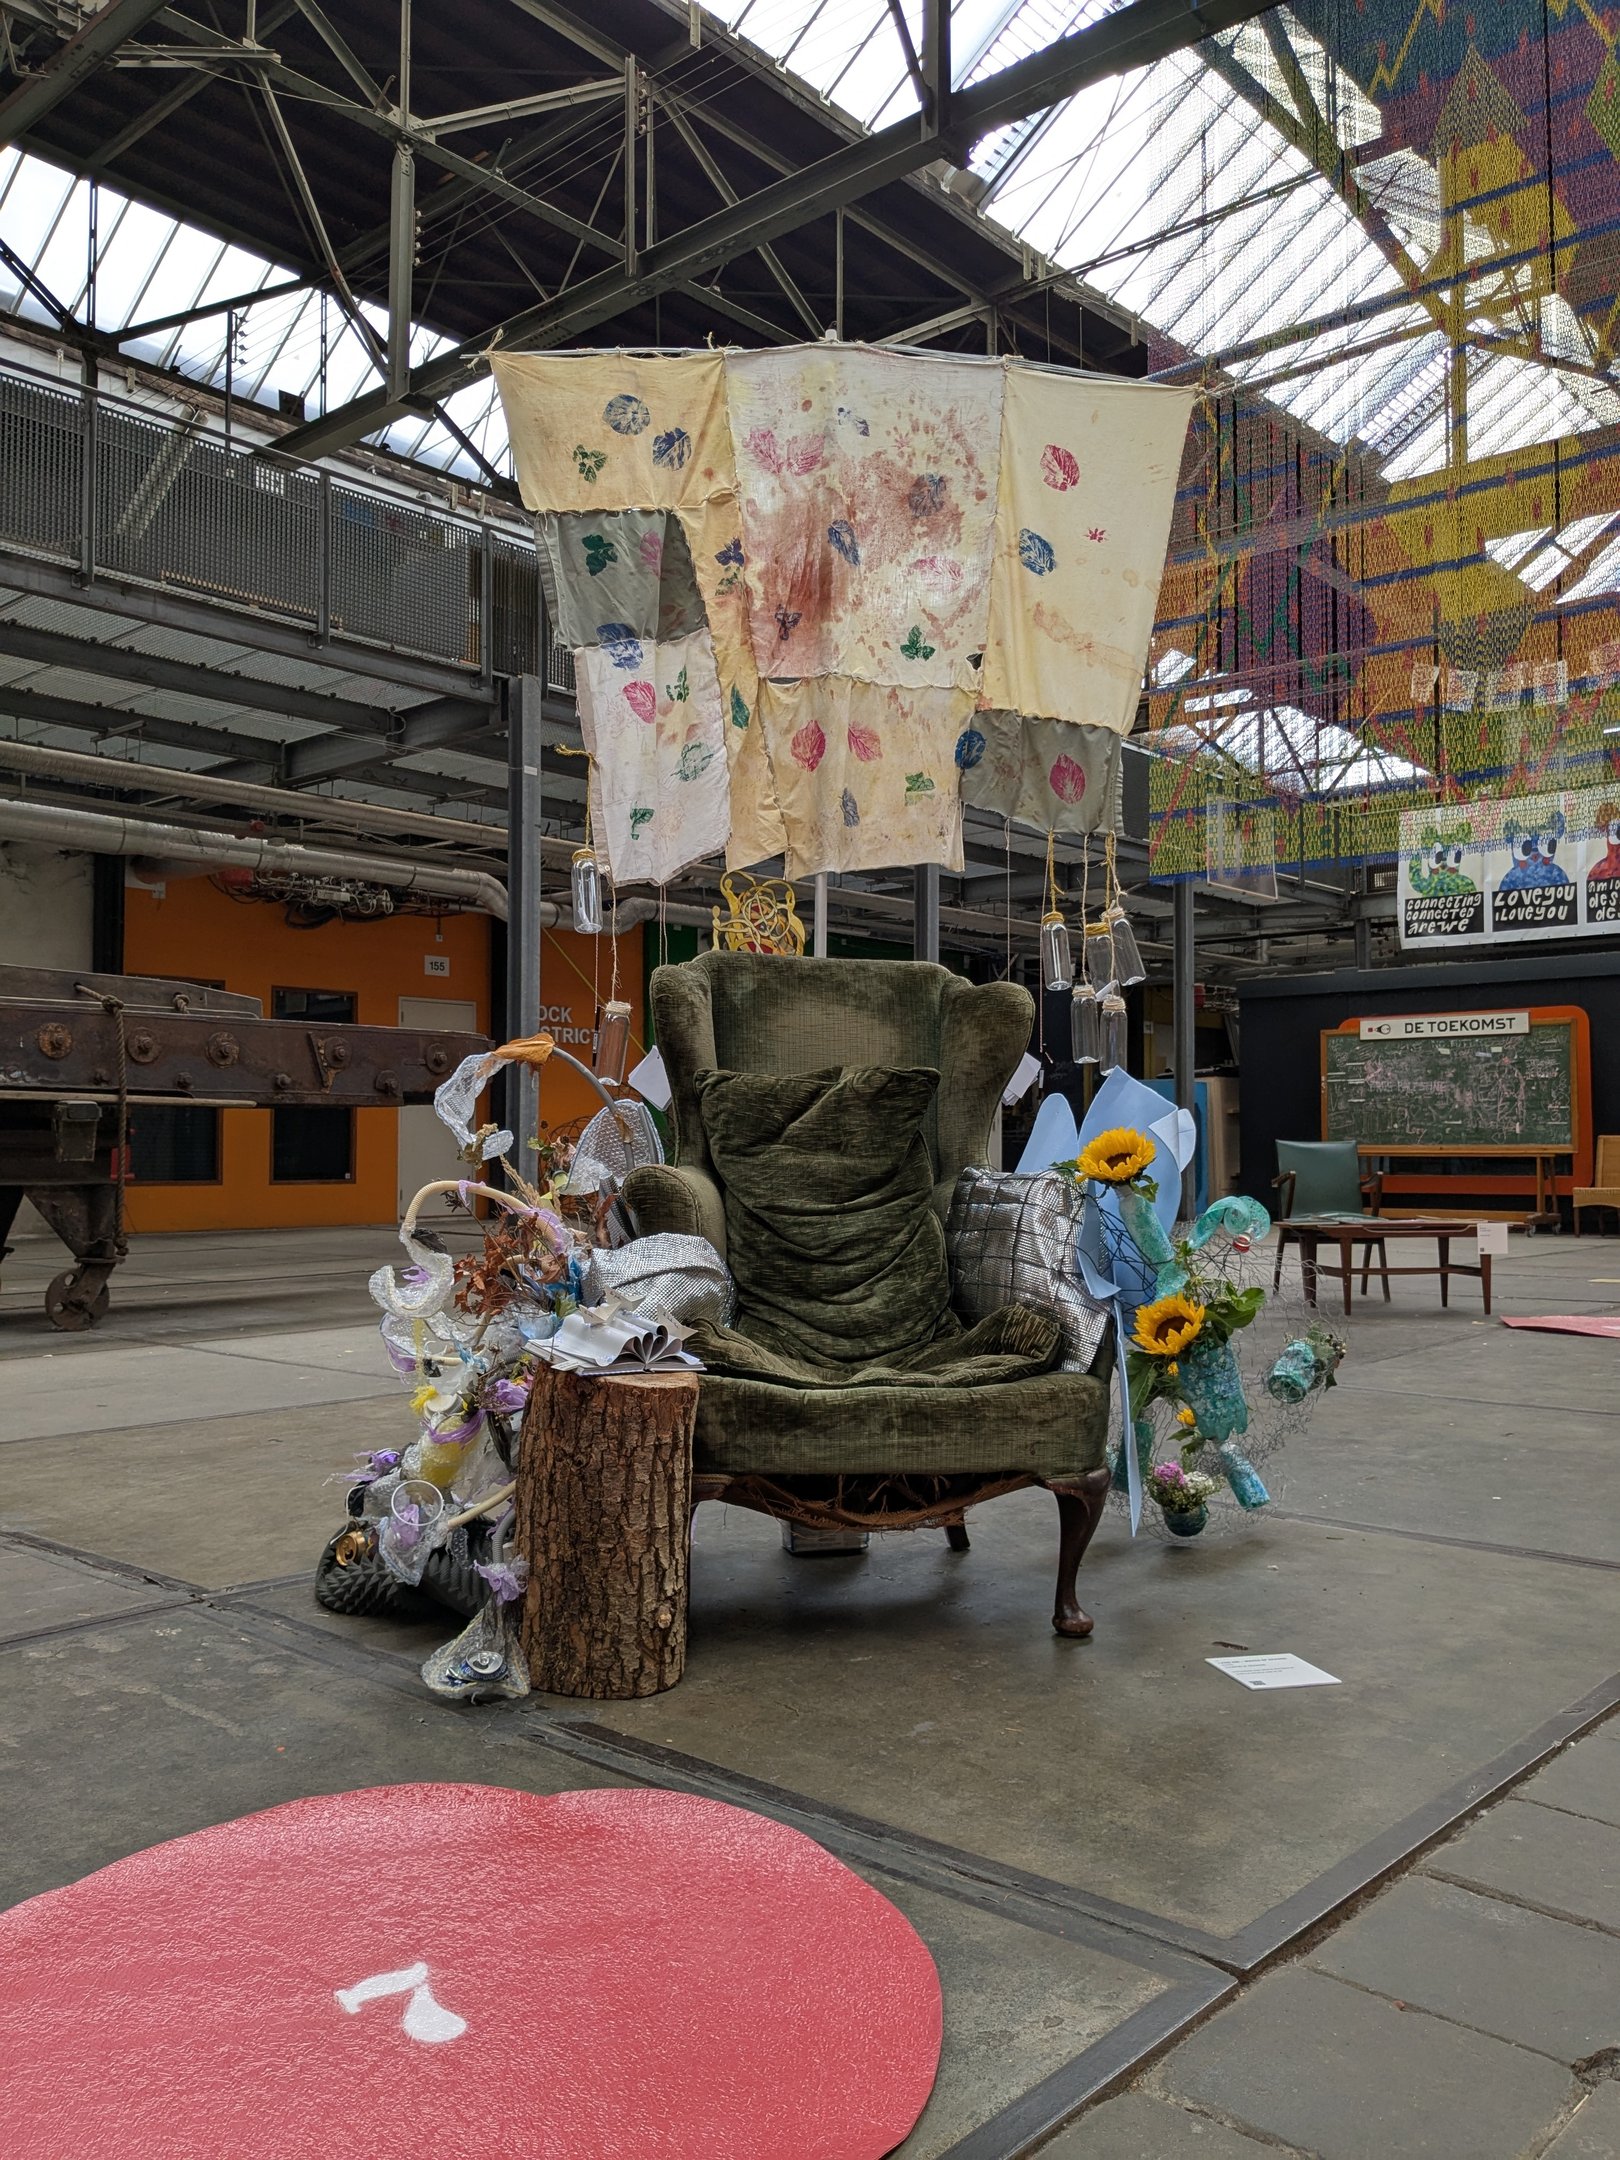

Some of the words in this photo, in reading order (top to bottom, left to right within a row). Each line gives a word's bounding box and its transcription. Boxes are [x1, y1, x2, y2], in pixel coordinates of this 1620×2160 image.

[429, 961, 446, 972] 155
[538, 1005, 572, 1023] OCK
[1404, 1022, 1424, 1034] DE
[1425, 1017, 1516, 1033] TOEKOMST
